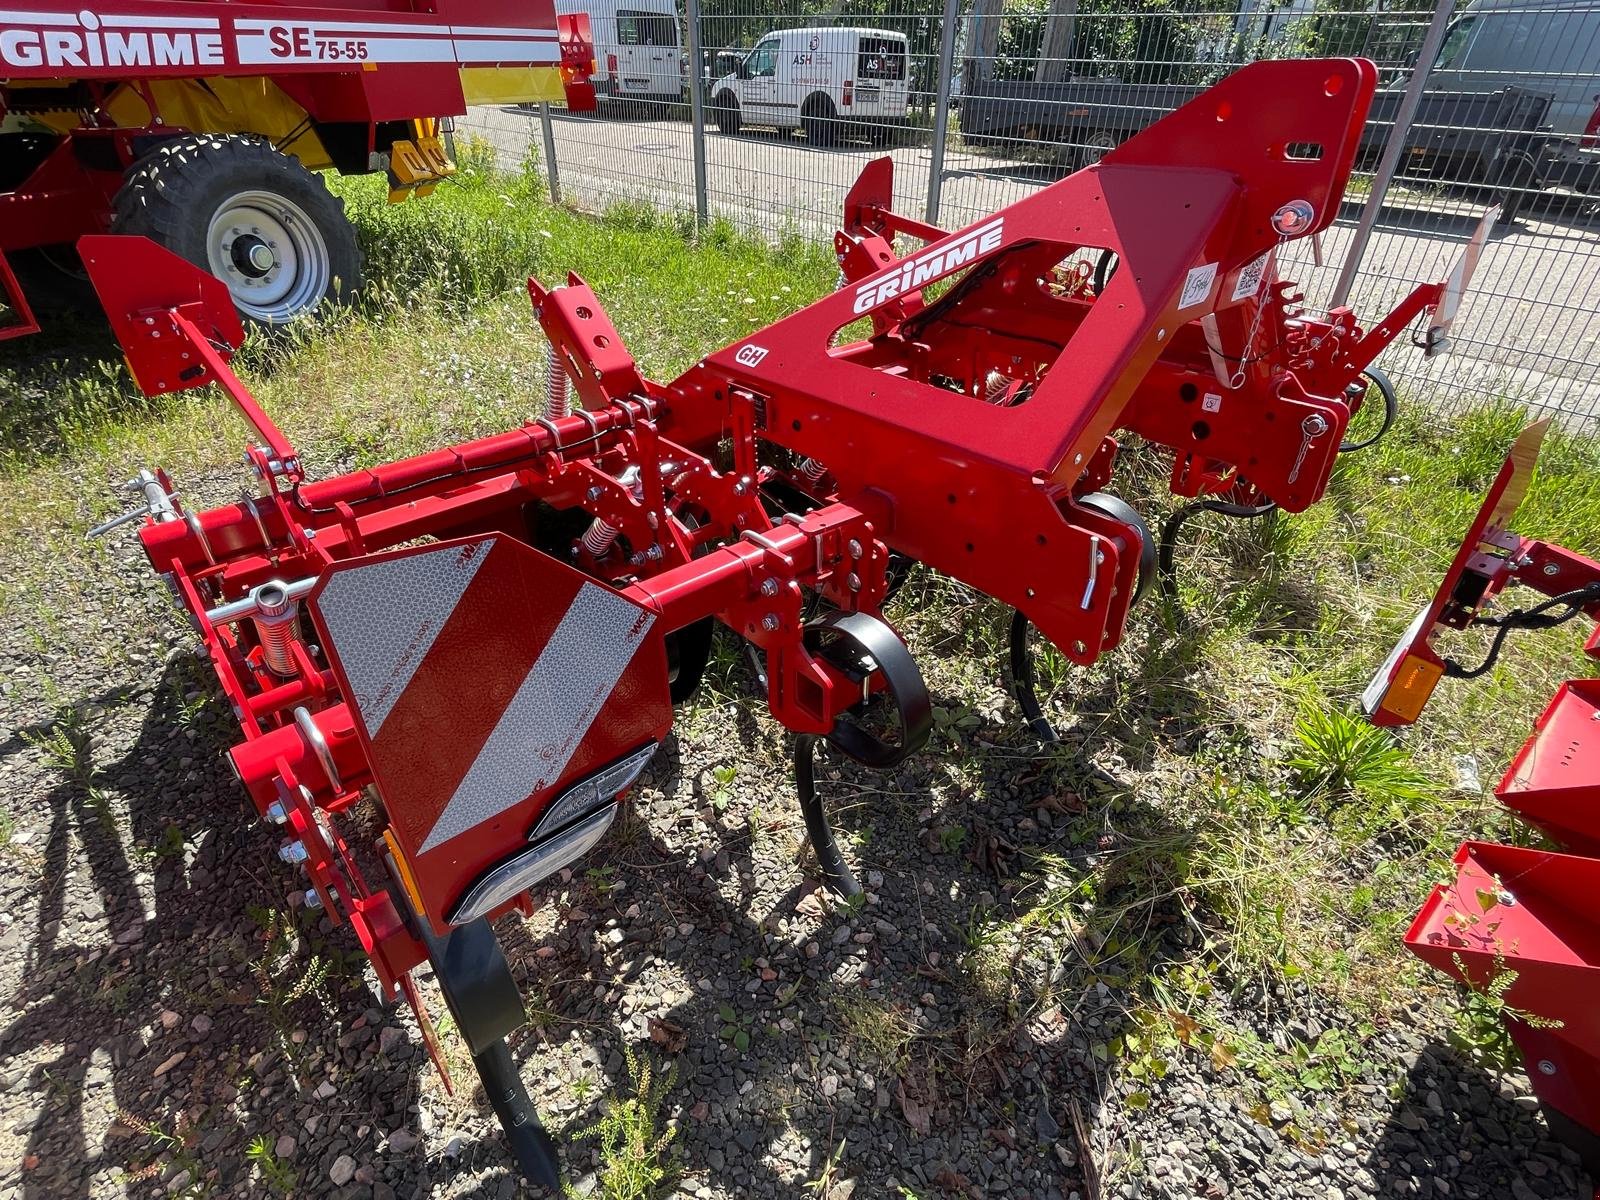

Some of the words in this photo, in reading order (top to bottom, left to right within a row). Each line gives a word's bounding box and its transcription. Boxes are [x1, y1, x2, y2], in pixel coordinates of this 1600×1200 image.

[269, 26, 312, 58] SE
[315, 41, 368, 60] 75-55
[792, 53, 812, 65] ASH
[738, 346, 765, 365] GH
